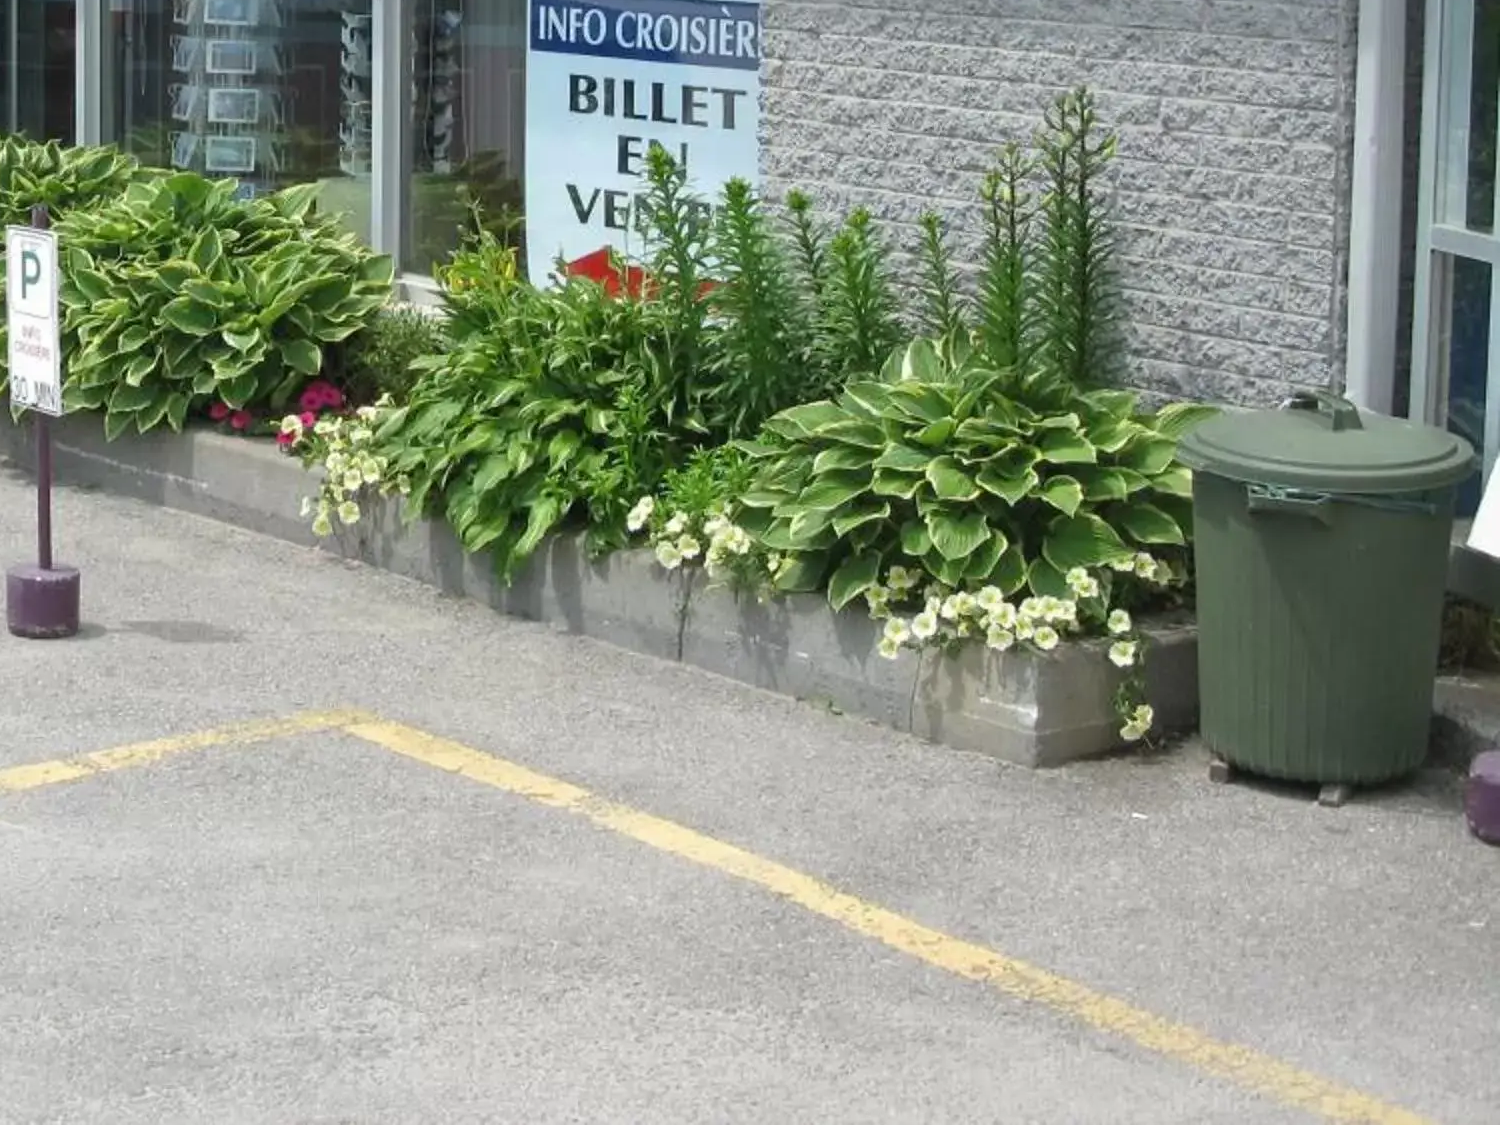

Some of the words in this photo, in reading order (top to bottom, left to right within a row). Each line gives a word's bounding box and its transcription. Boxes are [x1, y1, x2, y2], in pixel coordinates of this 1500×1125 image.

[538, 5, 607, 46] INFO
[615, 5, 761, 58] CROISIÈR
[569, 74, 748, 130] BILLET
[617, 134, 688, 182] EN
[21, 250, 41, 299] P
